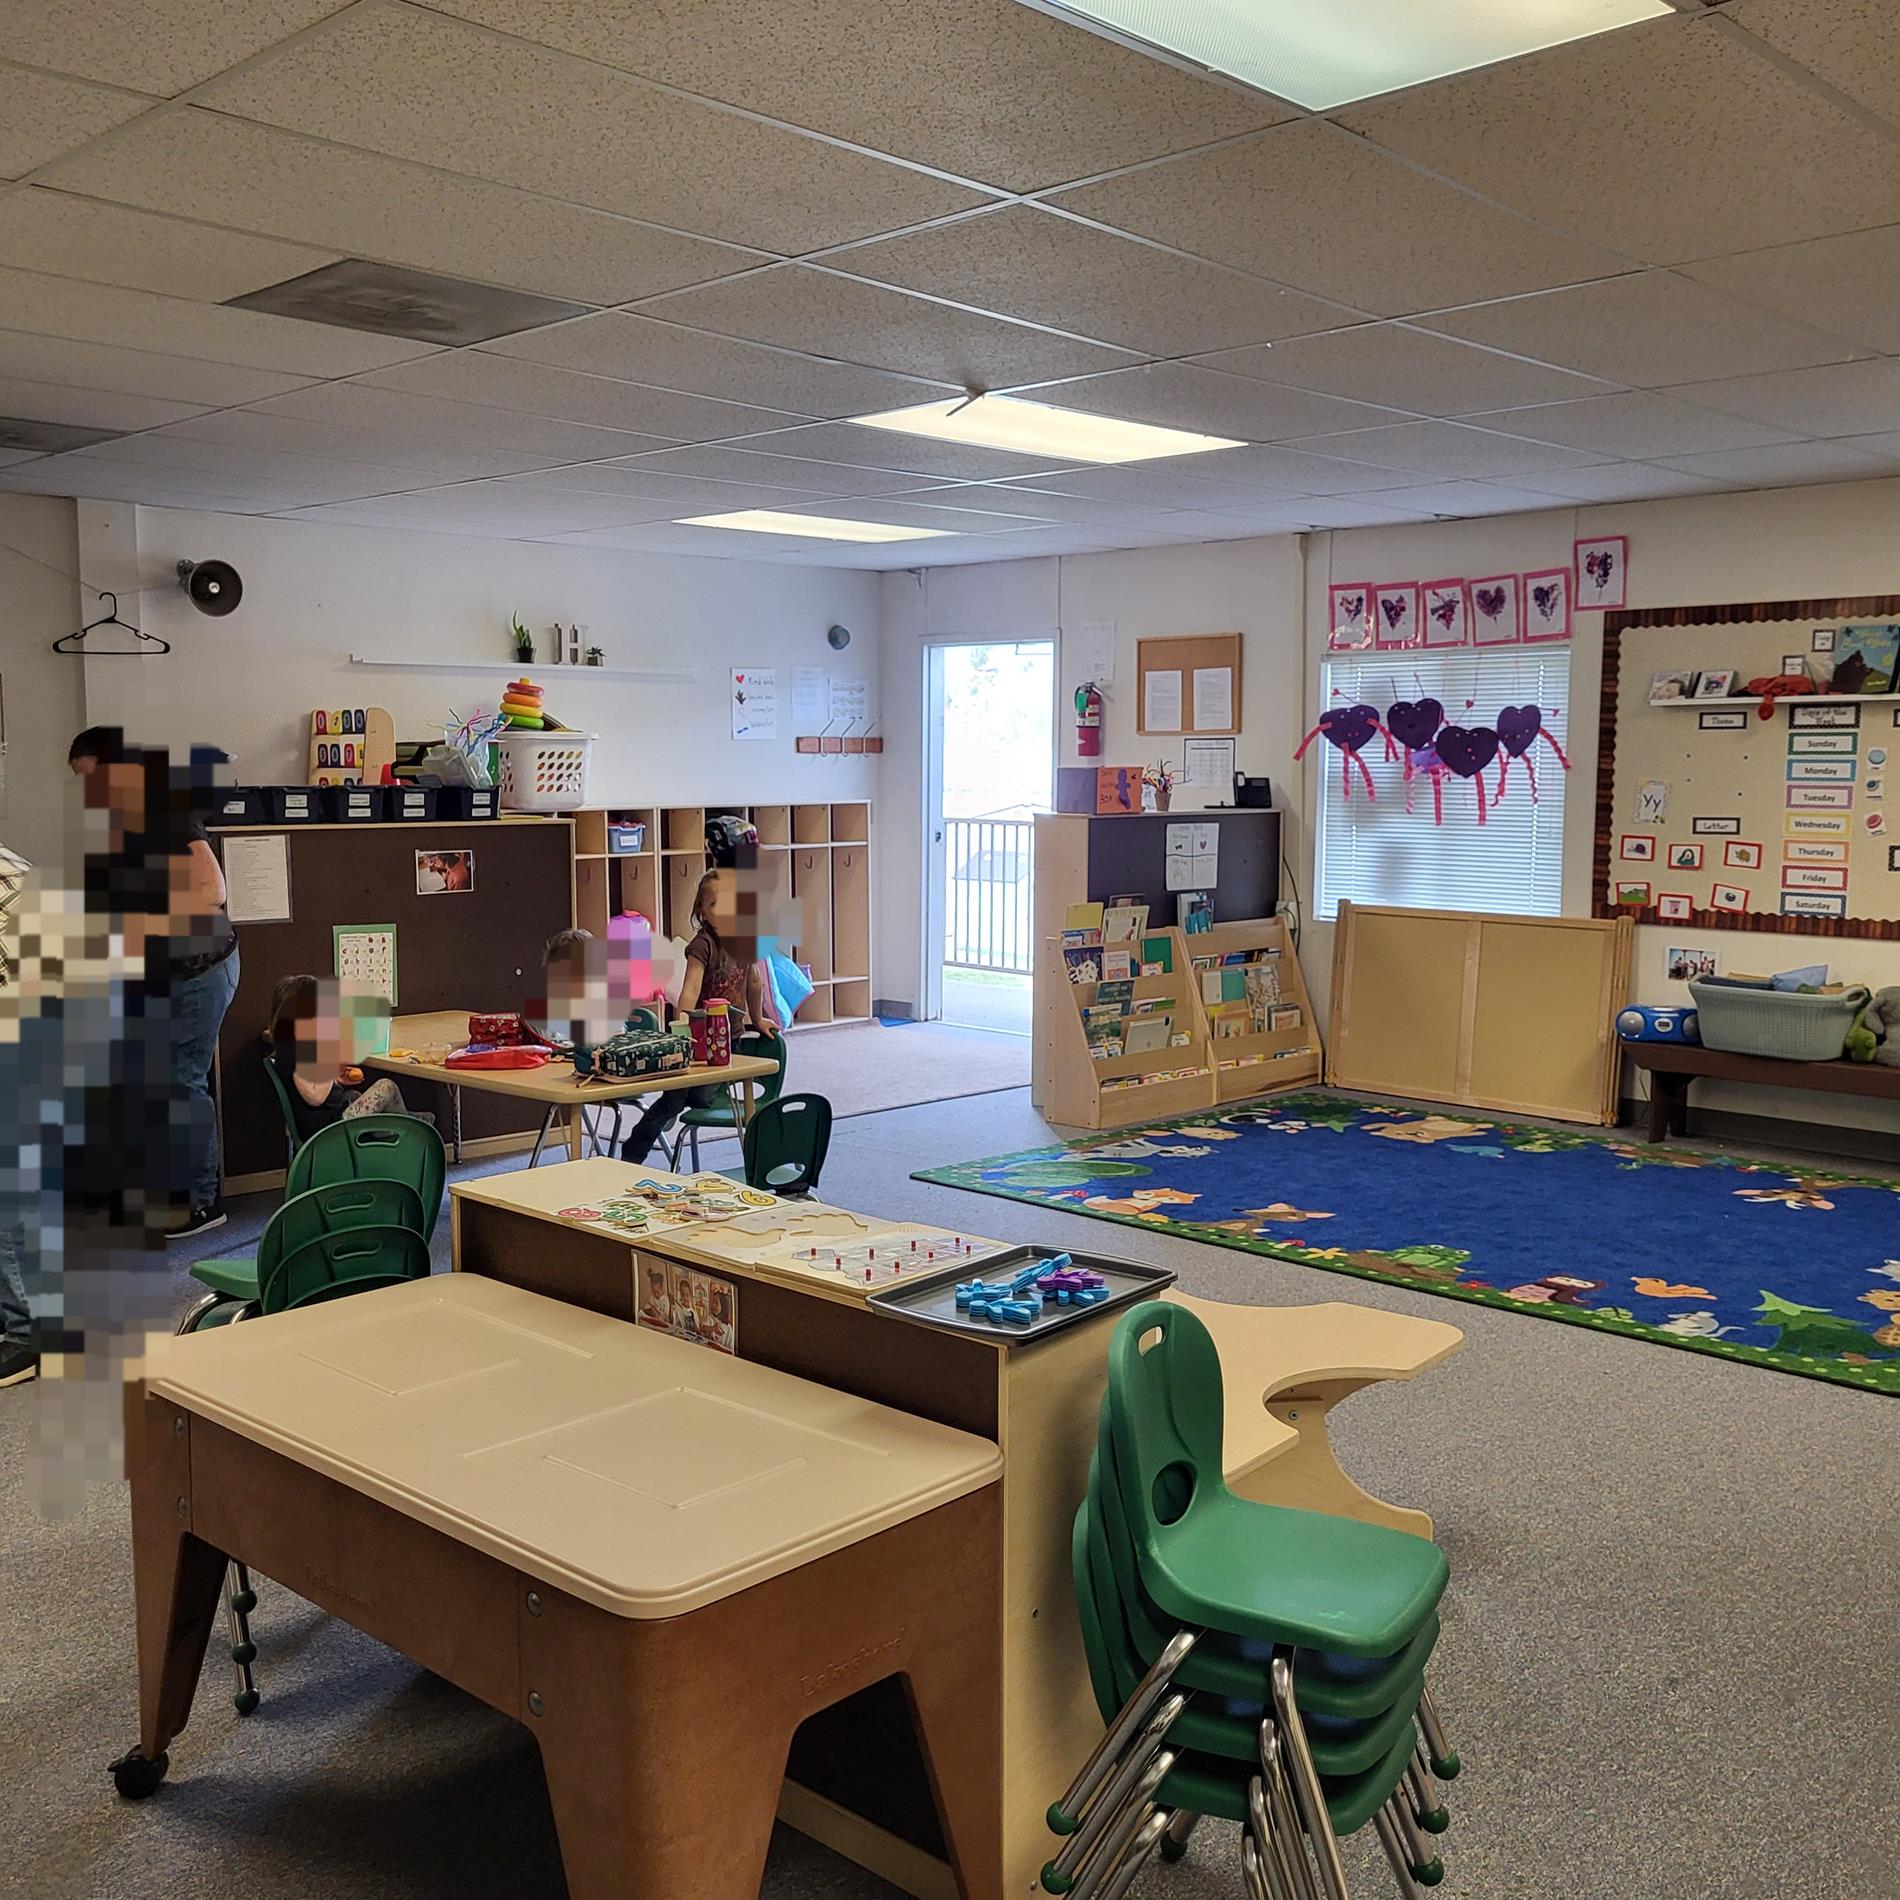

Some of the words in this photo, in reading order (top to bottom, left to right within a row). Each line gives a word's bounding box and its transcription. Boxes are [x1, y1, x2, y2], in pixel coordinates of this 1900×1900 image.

[1807, 740, 1837, 749] Sunday
[1804, 767, 1838, 776] Monday
[1643, 794, 1662, 813] Yy
[1803, 794, 1835, 803] Tuesday
[1703, 822, 1730, 830] Letter
[1794, 820, 1841, 830] Wednesday
[1797, 847, 1835, 857] Thursday
[1802, 873, 1827, 884] Friday
[1794, 900, 1831, 911] Saturday
